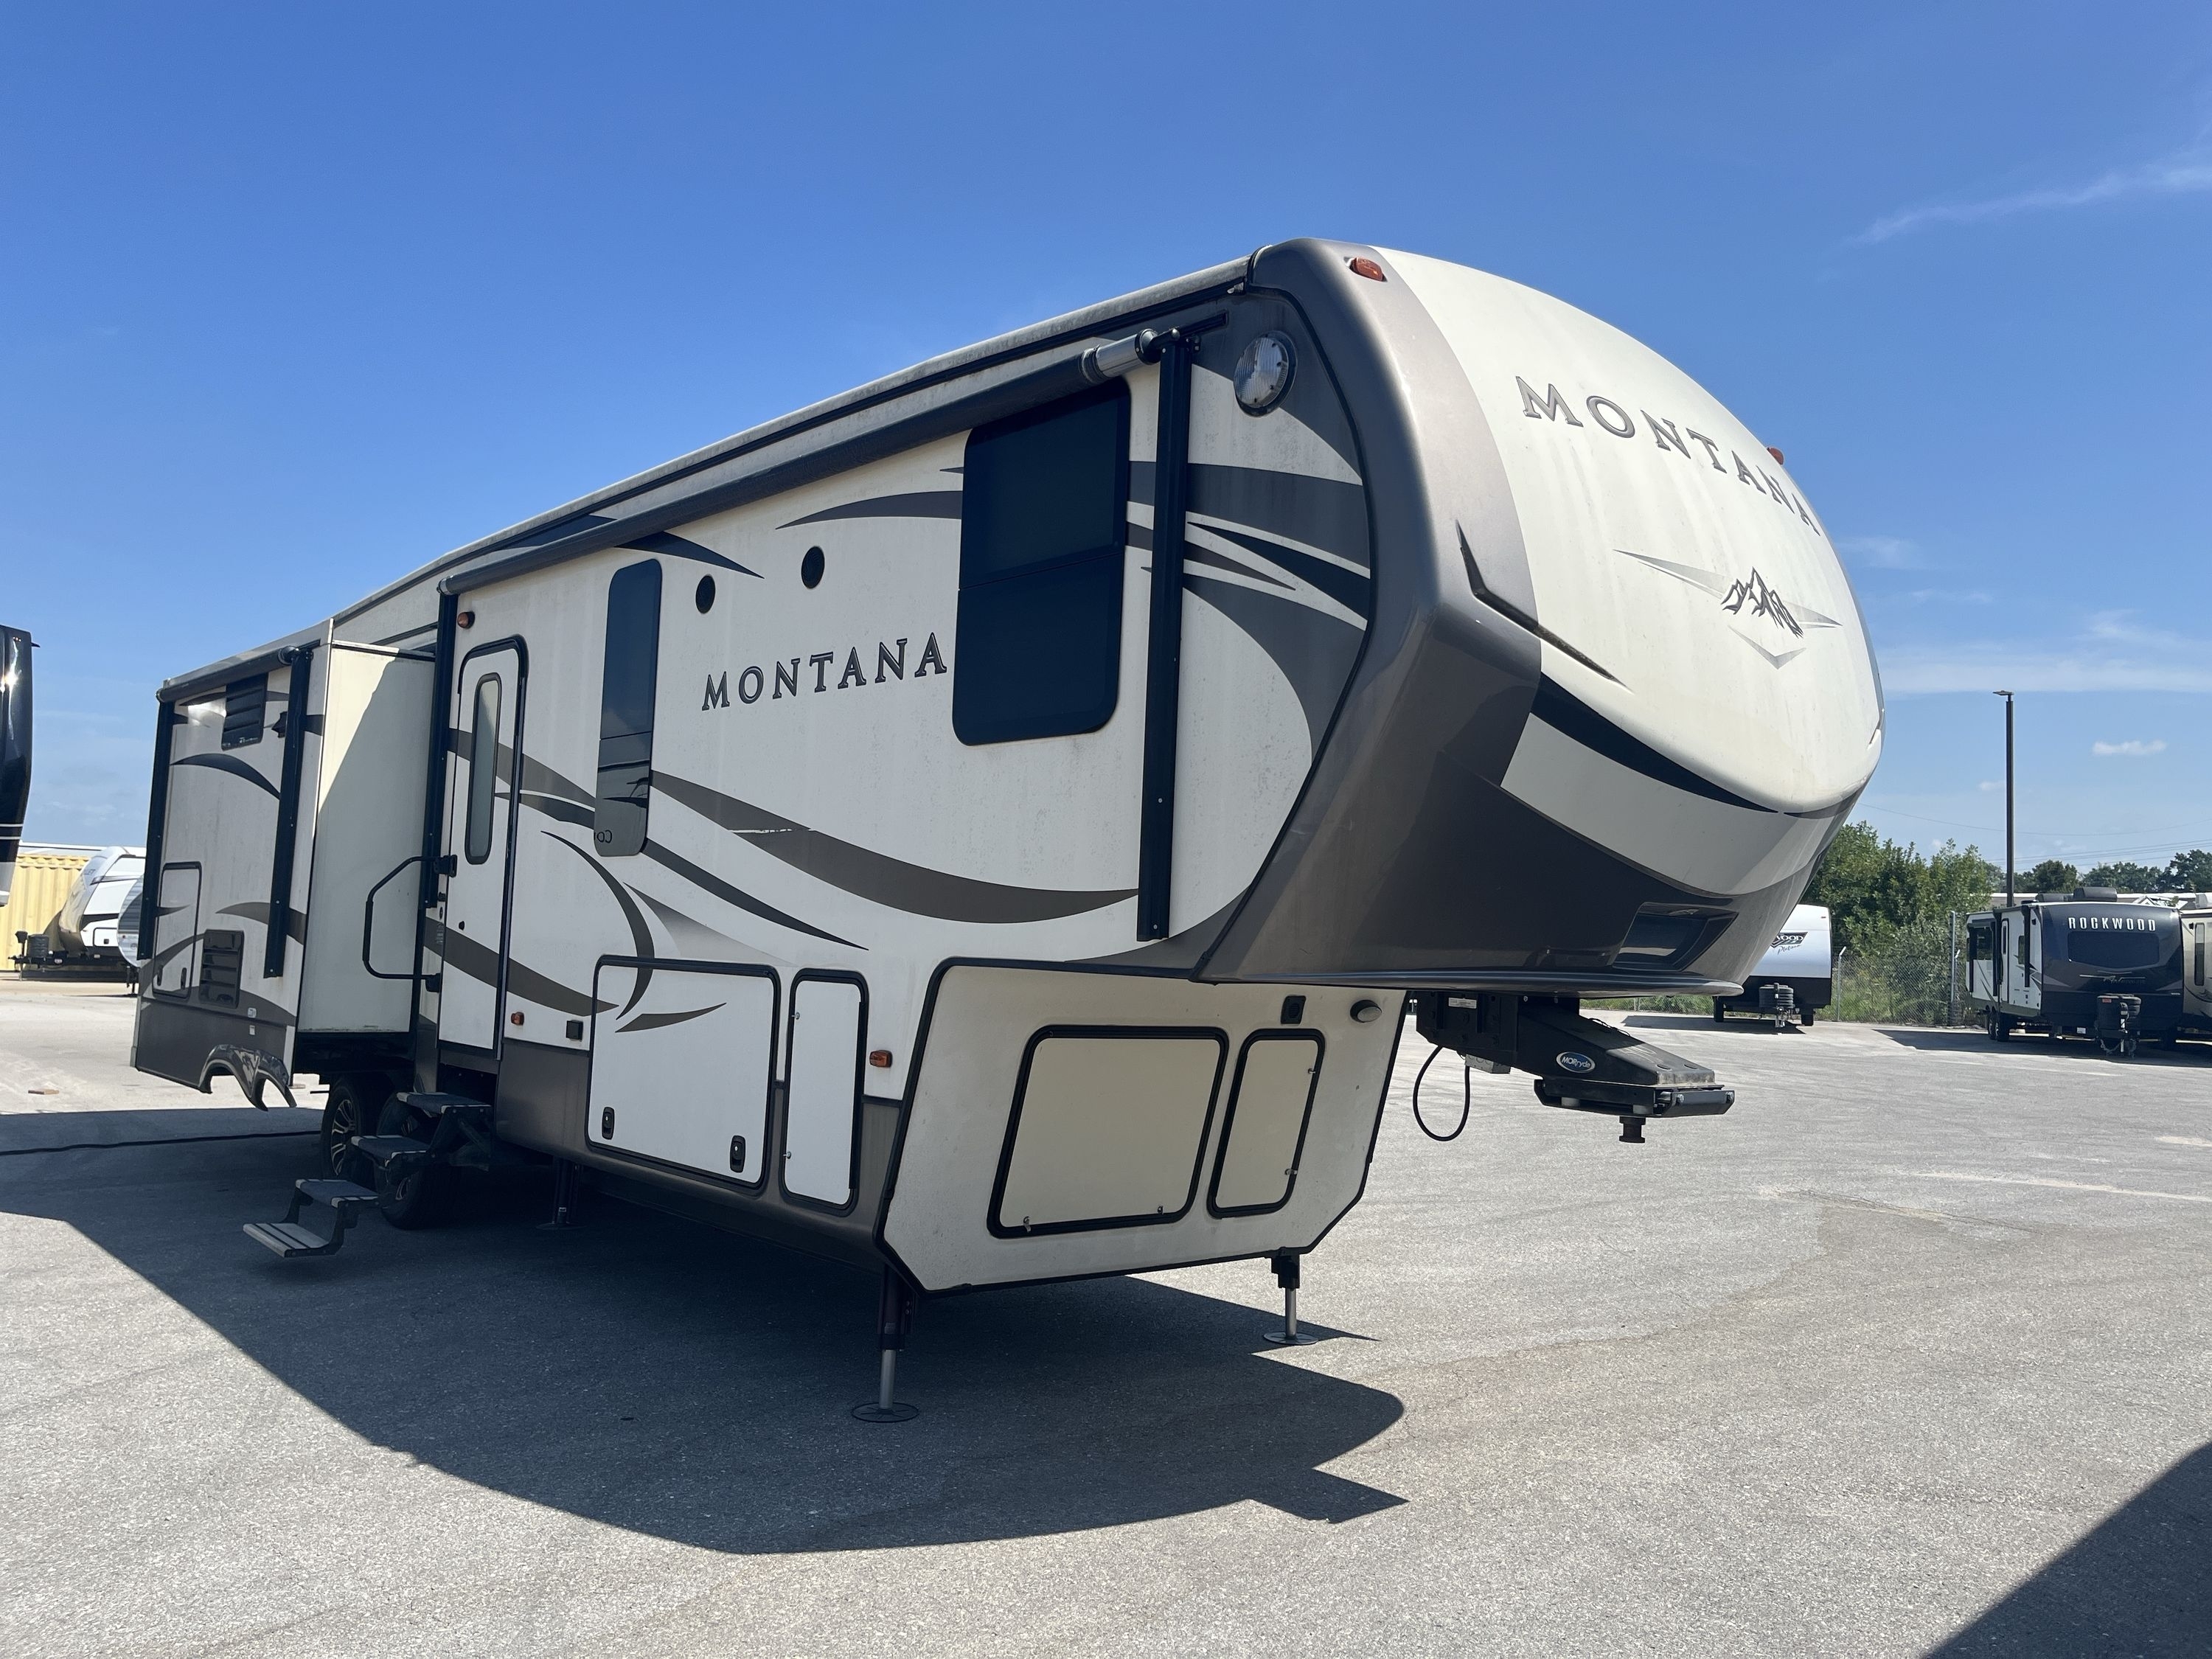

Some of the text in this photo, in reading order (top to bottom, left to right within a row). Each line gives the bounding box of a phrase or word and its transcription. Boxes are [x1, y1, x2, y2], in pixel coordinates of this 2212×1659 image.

[1515, 375, 1821, 537] MONTANA
[701, 632, 947, 712] MONTANA
[2067, 917, 2156, 931] ROCKWOOD
